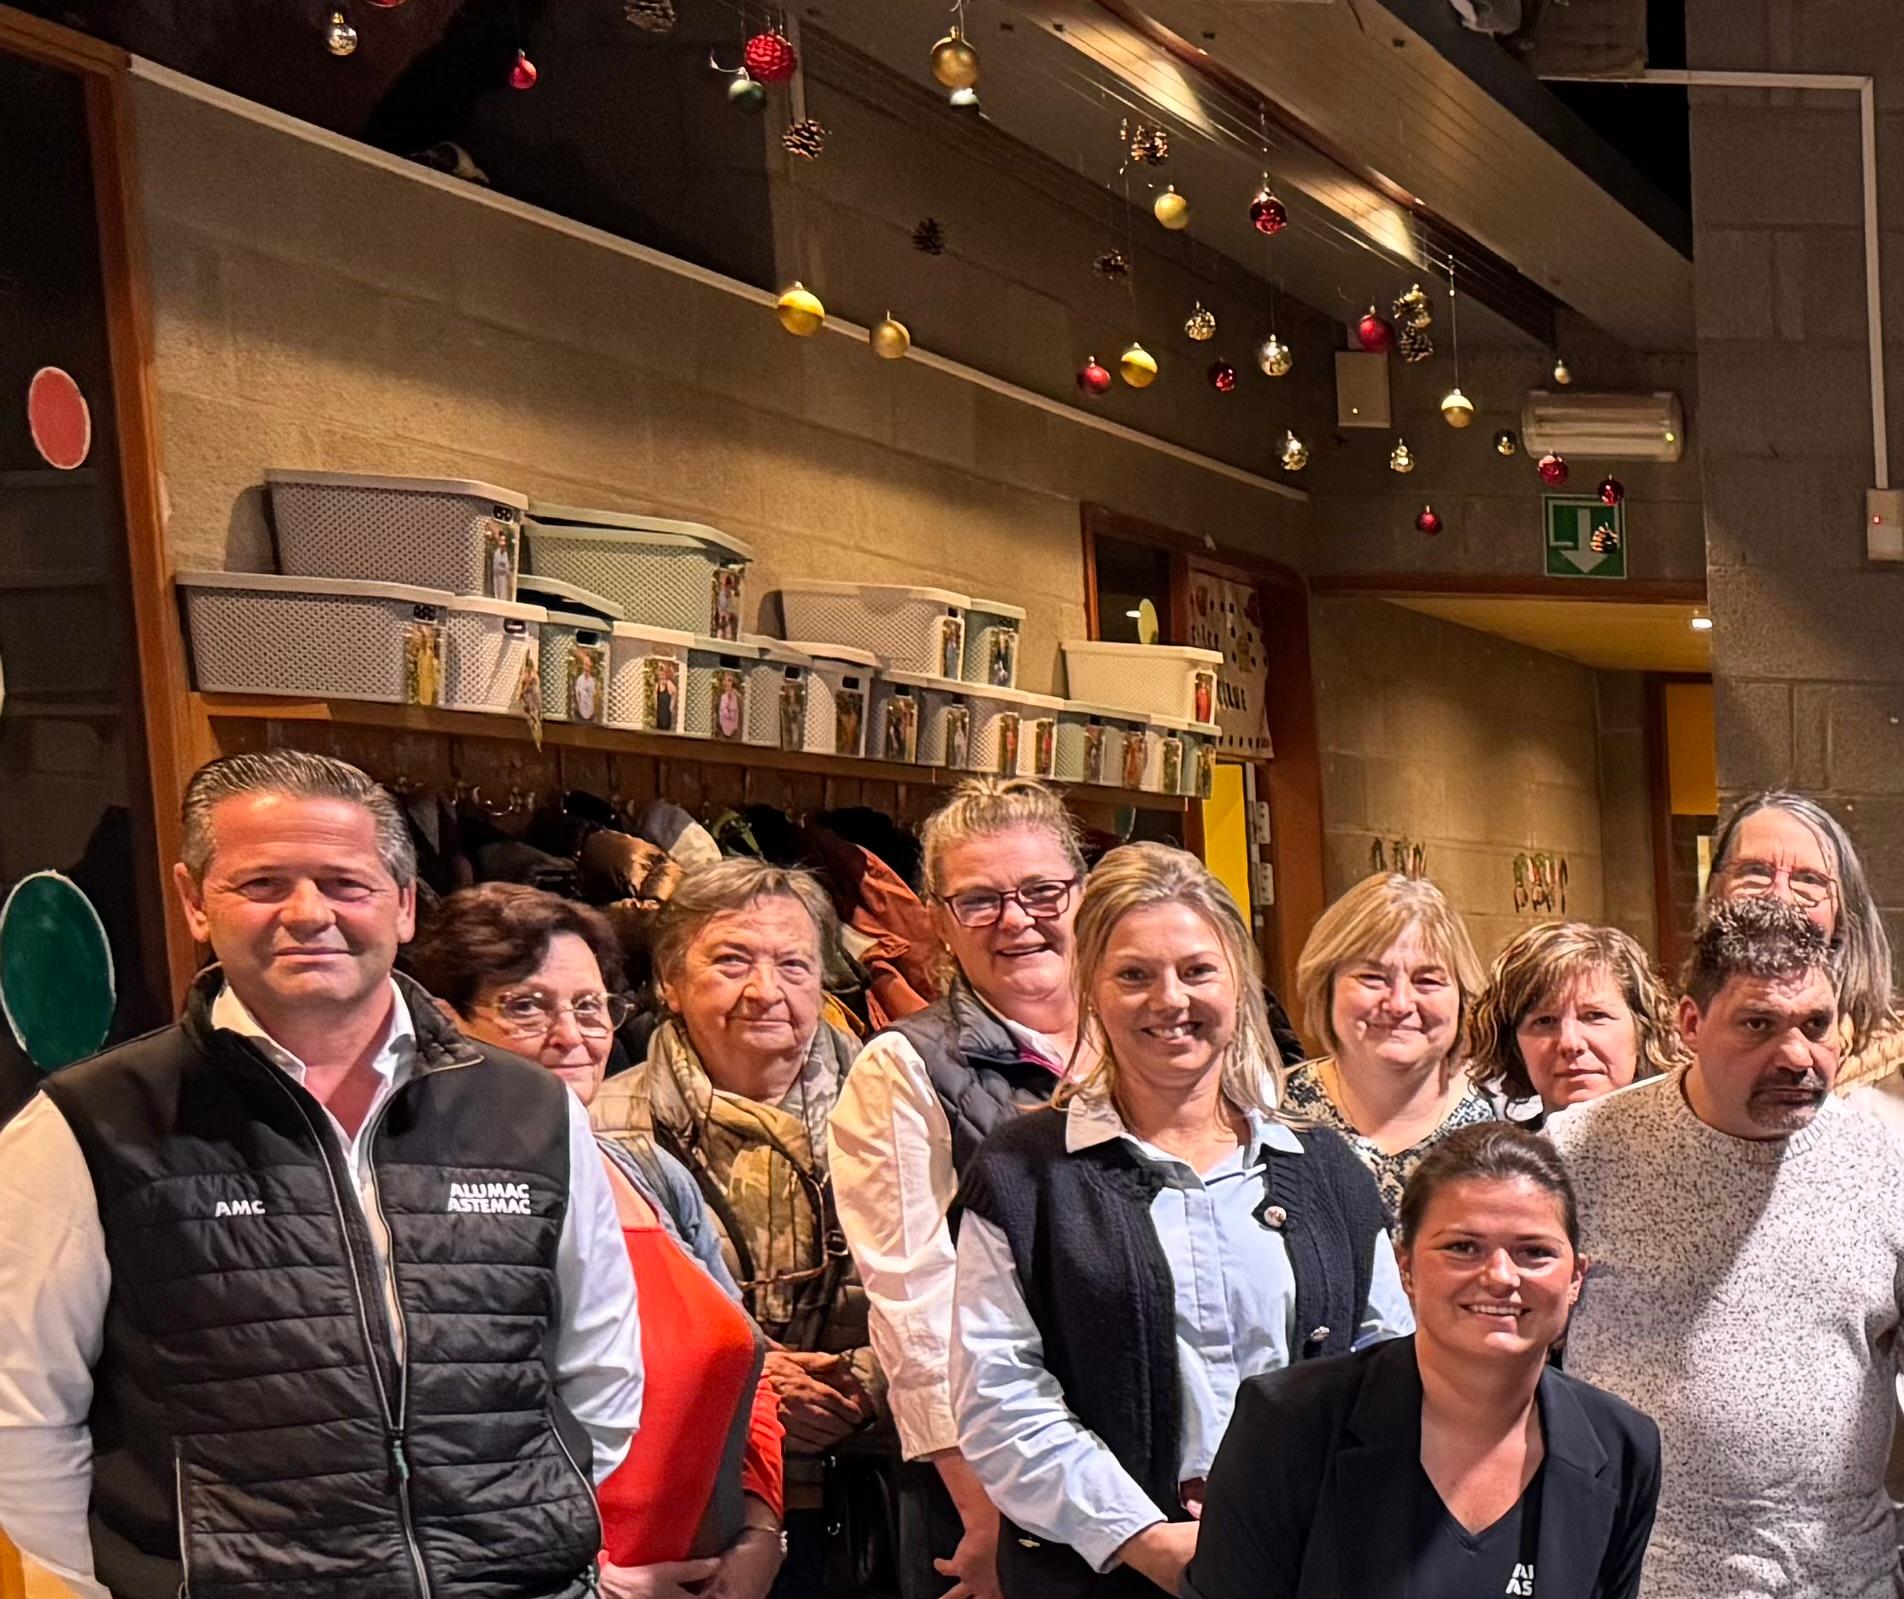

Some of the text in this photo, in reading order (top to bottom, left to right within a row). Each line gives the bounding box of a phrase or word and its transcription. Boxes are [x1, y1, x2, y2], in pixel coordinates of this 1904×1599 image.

[450, 1183, 529, 1199] ALUMAC
[215, 1200, 265, 1216] AMC
[448, 1198, 531, 1214] ASTEMAC
